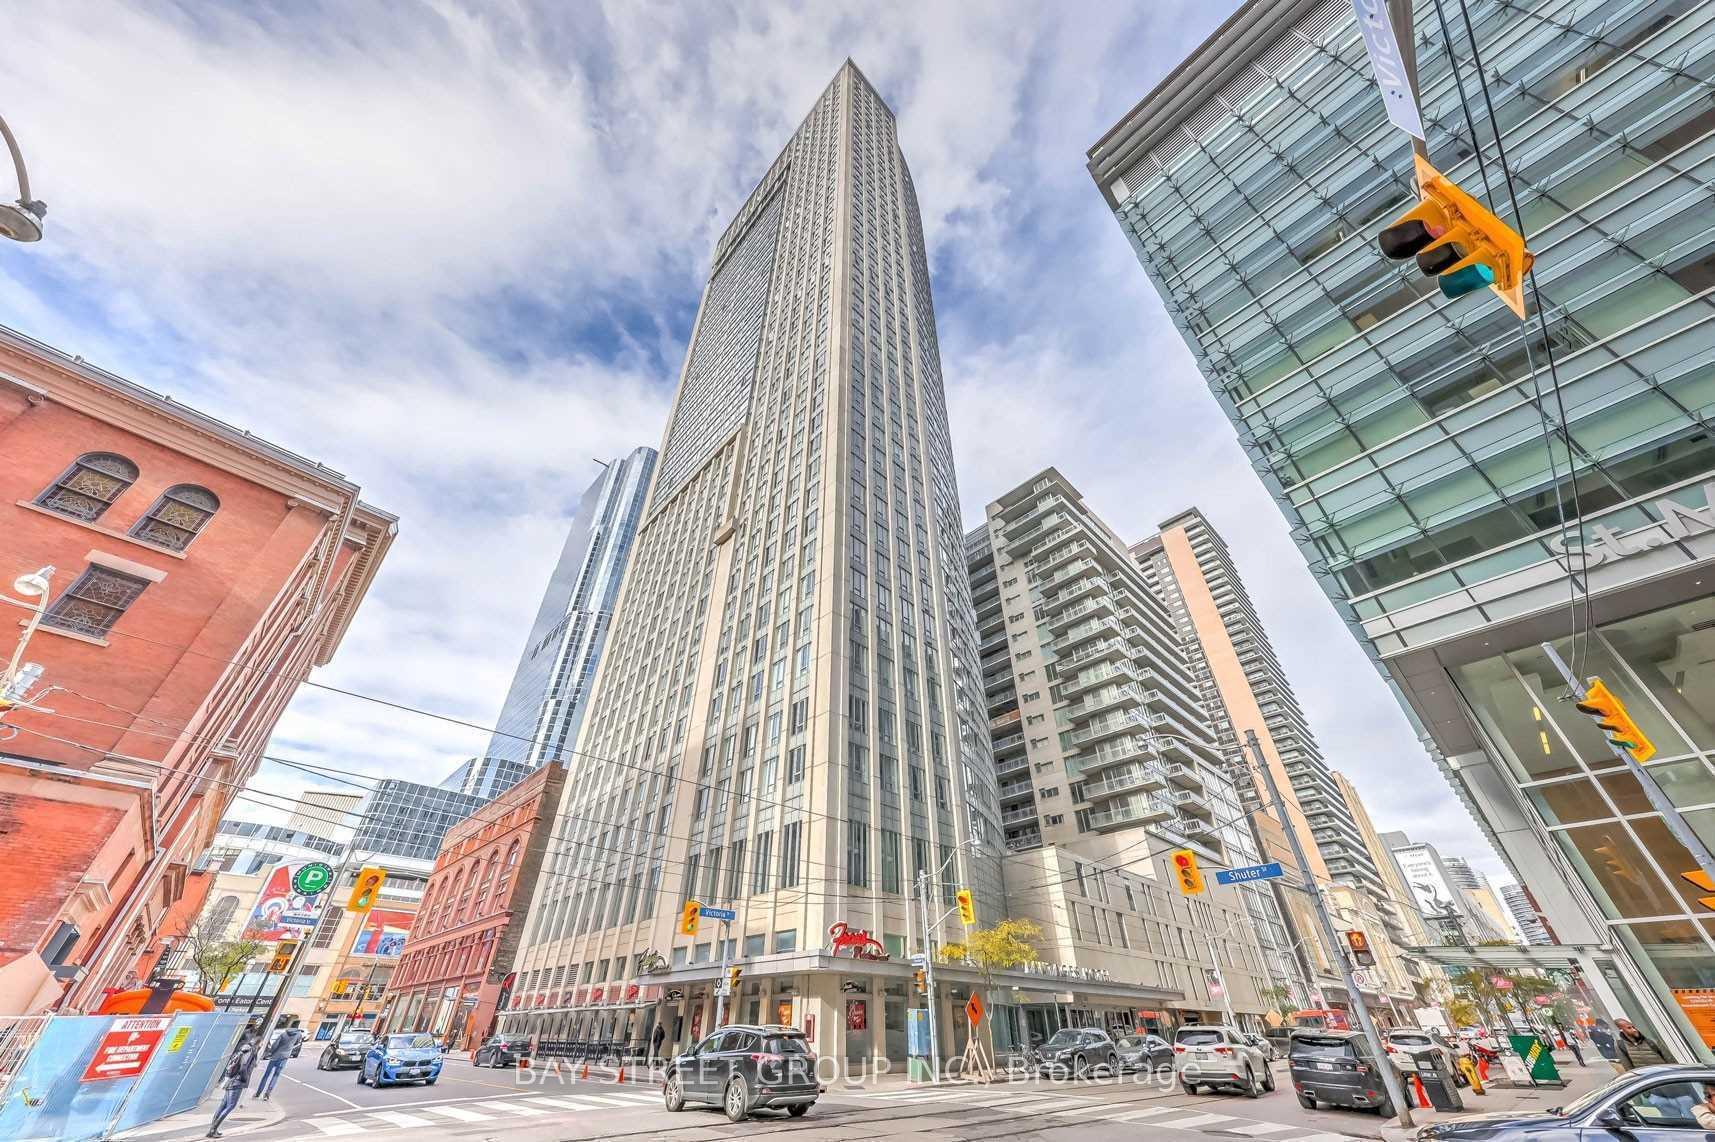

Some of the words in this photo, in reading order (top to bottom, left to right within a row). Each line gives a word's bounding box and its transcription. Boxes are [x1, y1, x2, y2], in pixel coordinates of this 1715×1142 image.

[1228, 869, 1261, 881] Shuter
[705, 909, 726, 918] Victoria
[121, 1019, 161, 1030] ATTENTION
